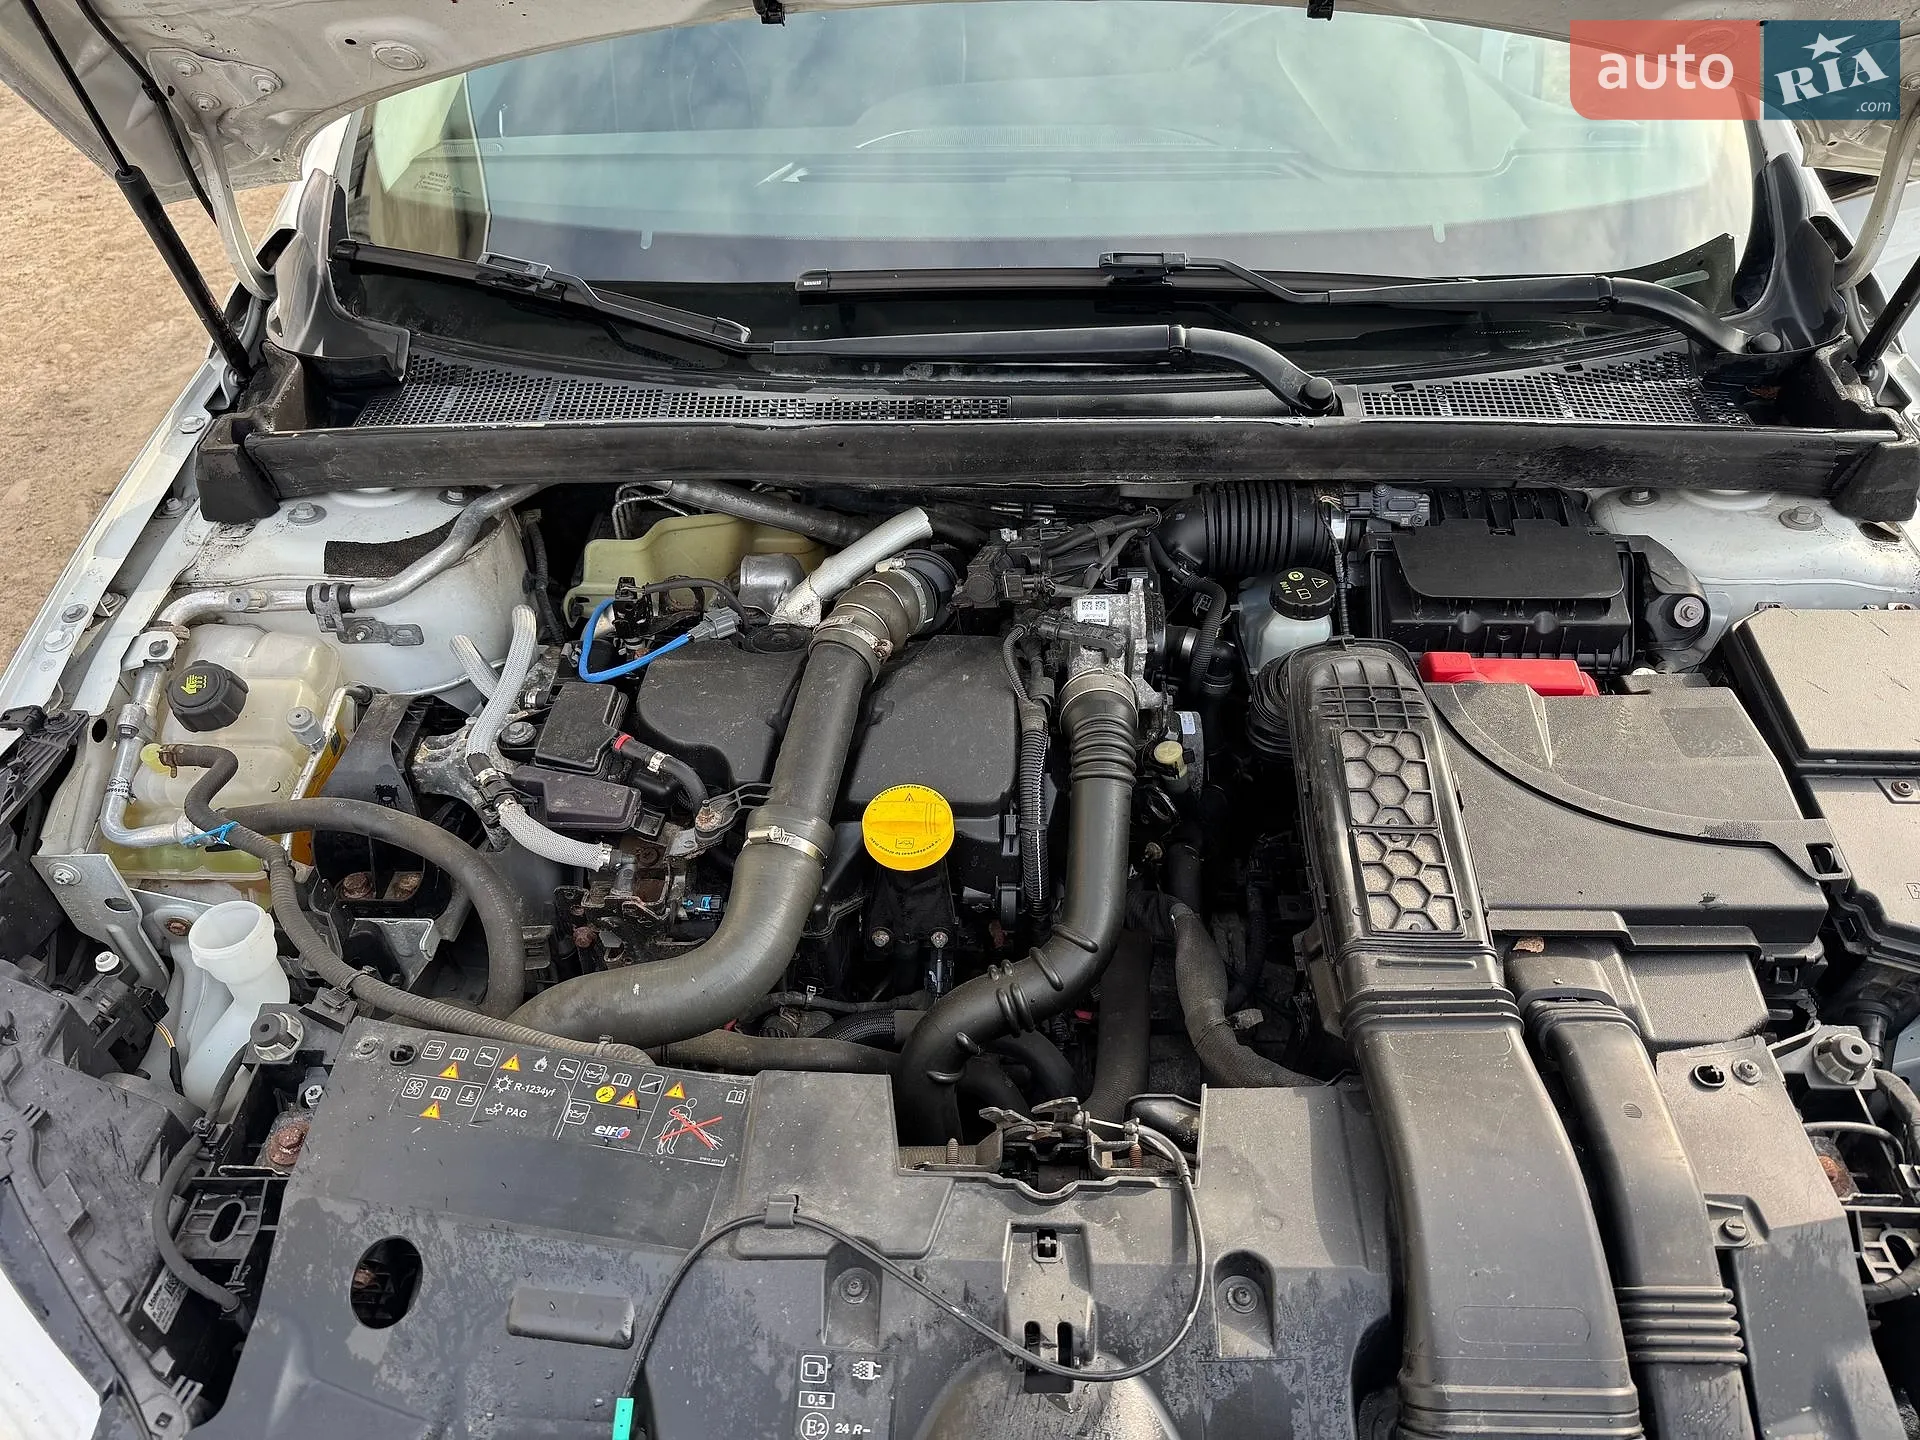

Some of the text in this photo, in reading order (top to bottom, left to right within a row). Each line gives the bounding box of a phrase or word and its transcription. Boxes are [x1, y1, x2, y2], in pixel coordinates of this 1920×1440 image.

[513, 1082, 556, 1098] R-1234yf
[505, 1107, 528, 1118] PAG
[594, 1125, 619, 1136] elf
[807, 1394, 826, 1406] 0,5
[805, 1419, 826, 1436] E2
[834, 1423, 850, 1434] 24
